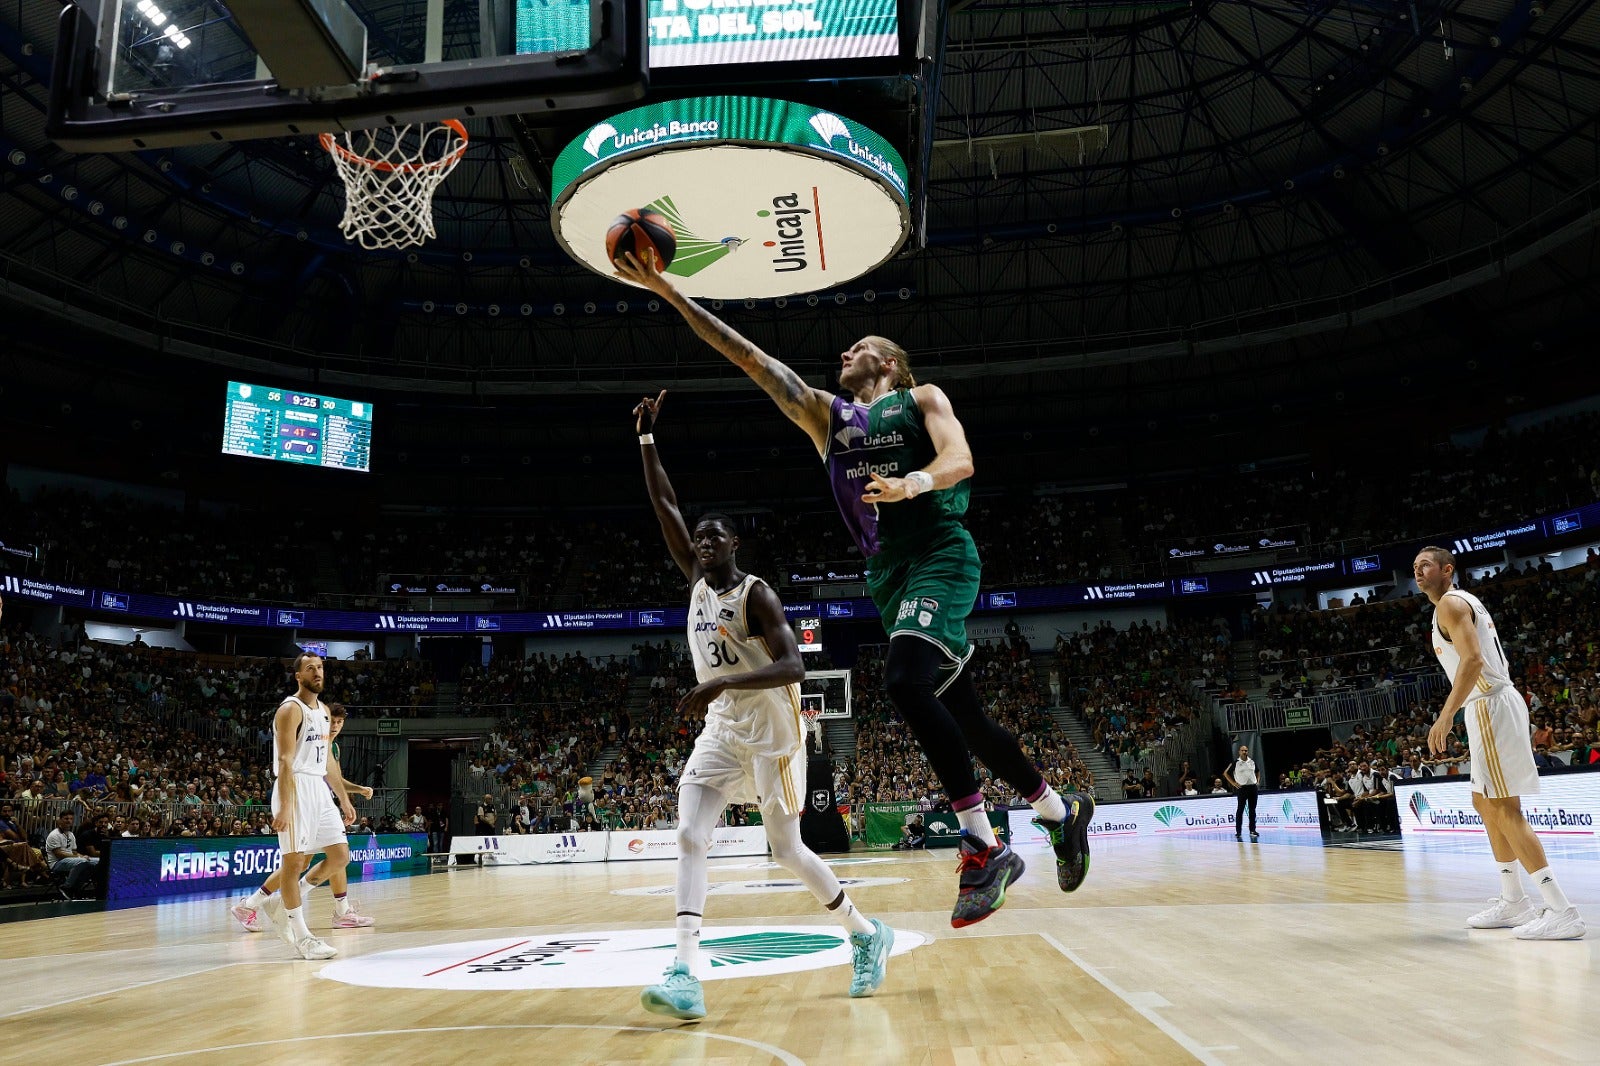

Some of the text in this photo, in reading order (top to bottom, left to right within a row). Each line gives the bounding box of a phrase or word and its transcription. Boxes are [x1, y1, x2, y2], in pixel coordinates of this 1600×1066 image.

[698, 12, 756, 36] DEL
[762, 9, 823, 33] SOL
[614, 120, 719, 149] Unicaja Banco
[848, 139, 887, 172] Unicaja
[757, 192, 812, 273] Unicaja
[267, 391, 336, 410] 56 9:25 50
[864, 430, 903, 446] Unicaja
[1506, 523, 1536, 536] Provincial
[1305, 562, 1335, 572] Provincial
[55, 584, 85, 596] Provincial
[1136, 581, 1165, 589] Provincial
[230, 607, 260, 616] Provincial
[800, 619, 820, 628] 9:25
[803, 629, 815, 644] 9
[1185, 814, 1224, 827] Unicaja
[1429, 809, 1484, 828] Unicaja Banco
[1560, 810, 1593, 827] Banco
[1104, 821, 1137, 832] Banco
[375, 846, 412, 860] BALONCESTO
[160, 848, 282, 882] REDES SOCIA
